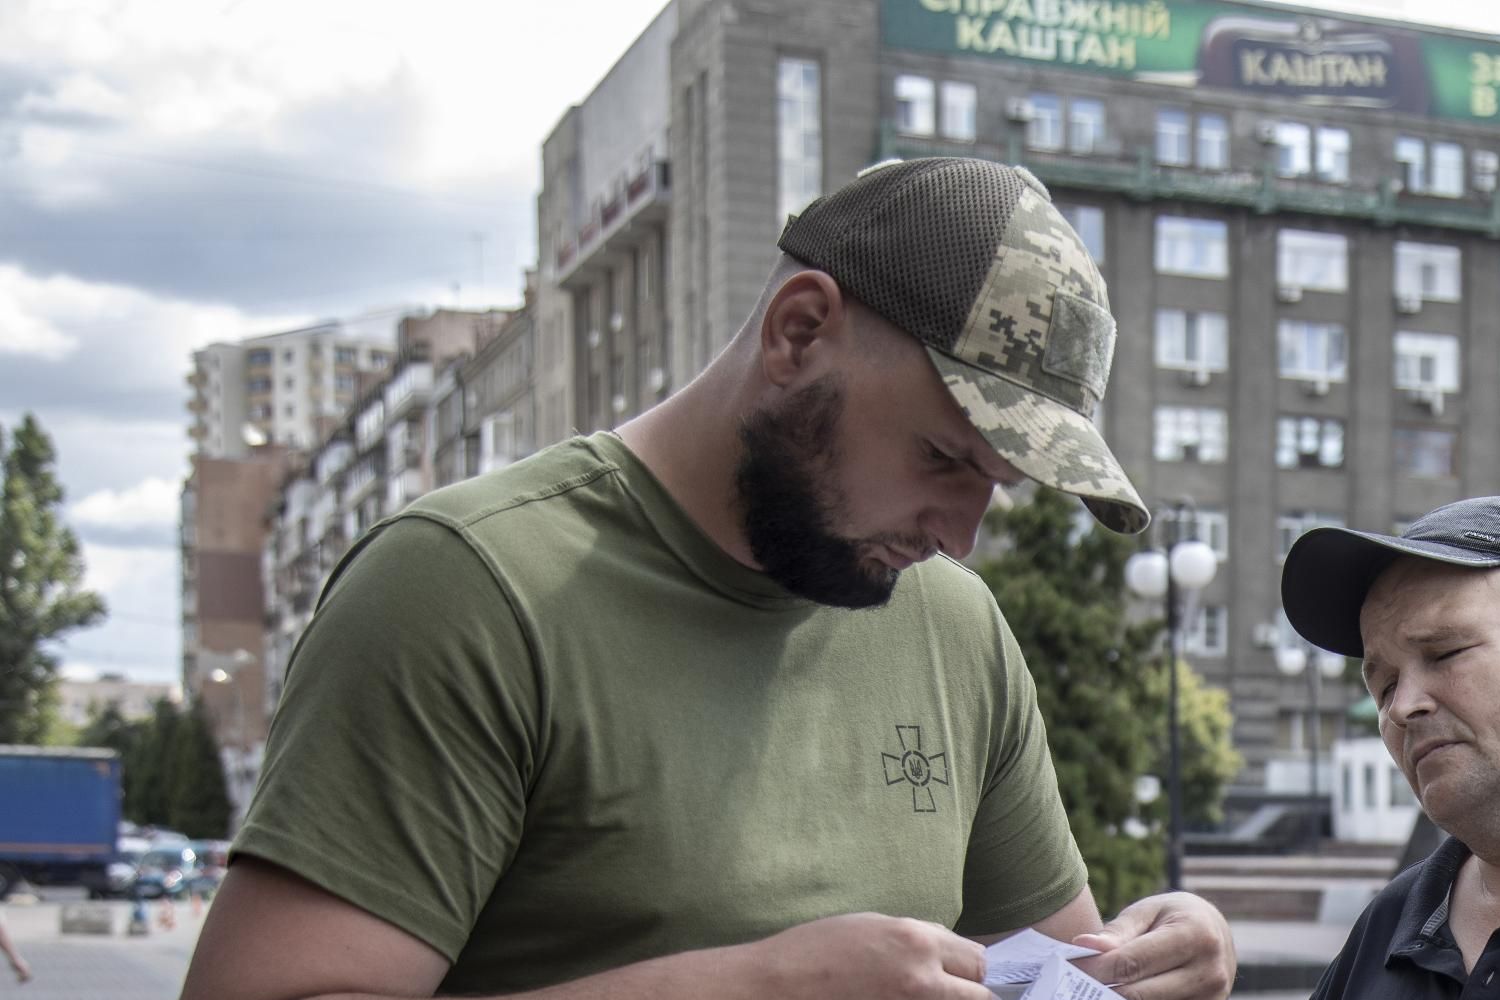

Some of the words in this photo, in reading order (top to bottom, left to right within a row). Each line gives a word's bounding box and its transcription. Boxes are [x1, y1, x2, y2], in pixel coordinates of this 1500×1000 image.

[957, 15, 1137, 70] КАШТАН
[1240, 49, 1387, 87] КАШТАН
[1471, 85, 1498, 117] В
